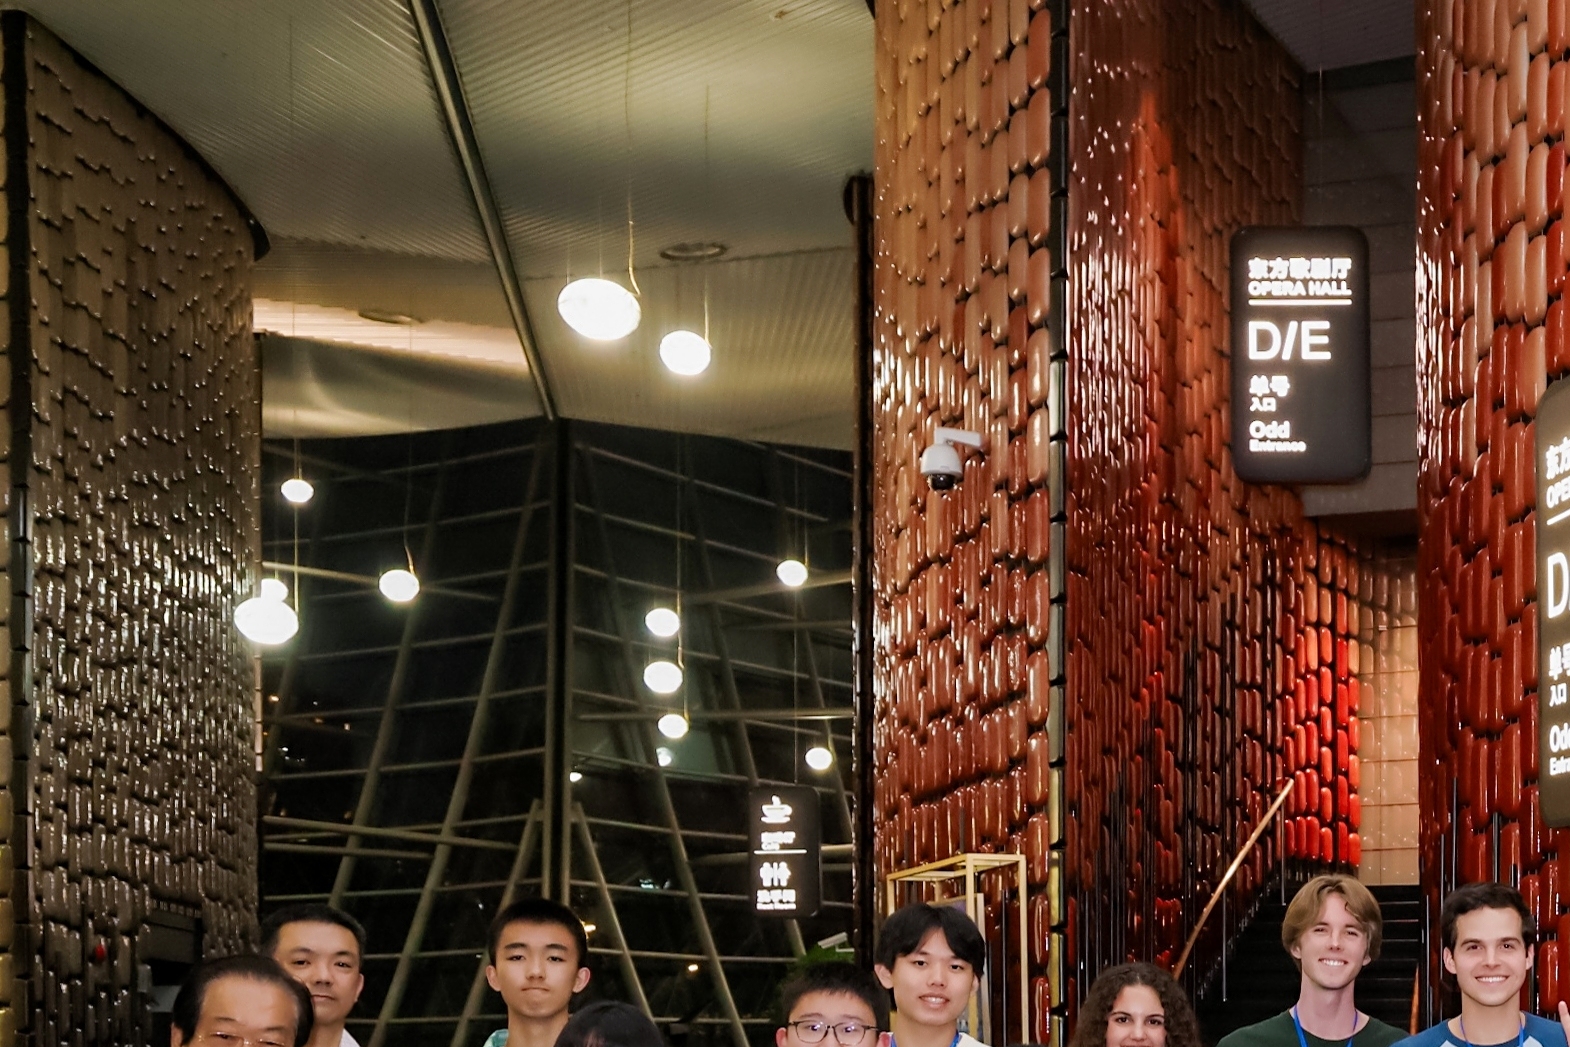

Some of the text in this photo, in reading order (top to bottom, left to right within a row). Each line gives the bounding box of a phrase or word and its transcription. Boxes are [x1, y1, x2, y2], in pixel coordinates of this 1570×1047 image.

[1248, 257, 1352, 279] 东方歌剧厅
[1248, 280, 1352, 296] OPERA HALL
[1248, 320, 1331, 361] D/E
[1249, 375, 1290, 397] 单号
[1250, 397, 1276, 412] 入口
[1249, 421, 1290, 439] Odd
[1249, 439, 1307, 452] Entrance
[1549, 682, 1567, 707] 入口
